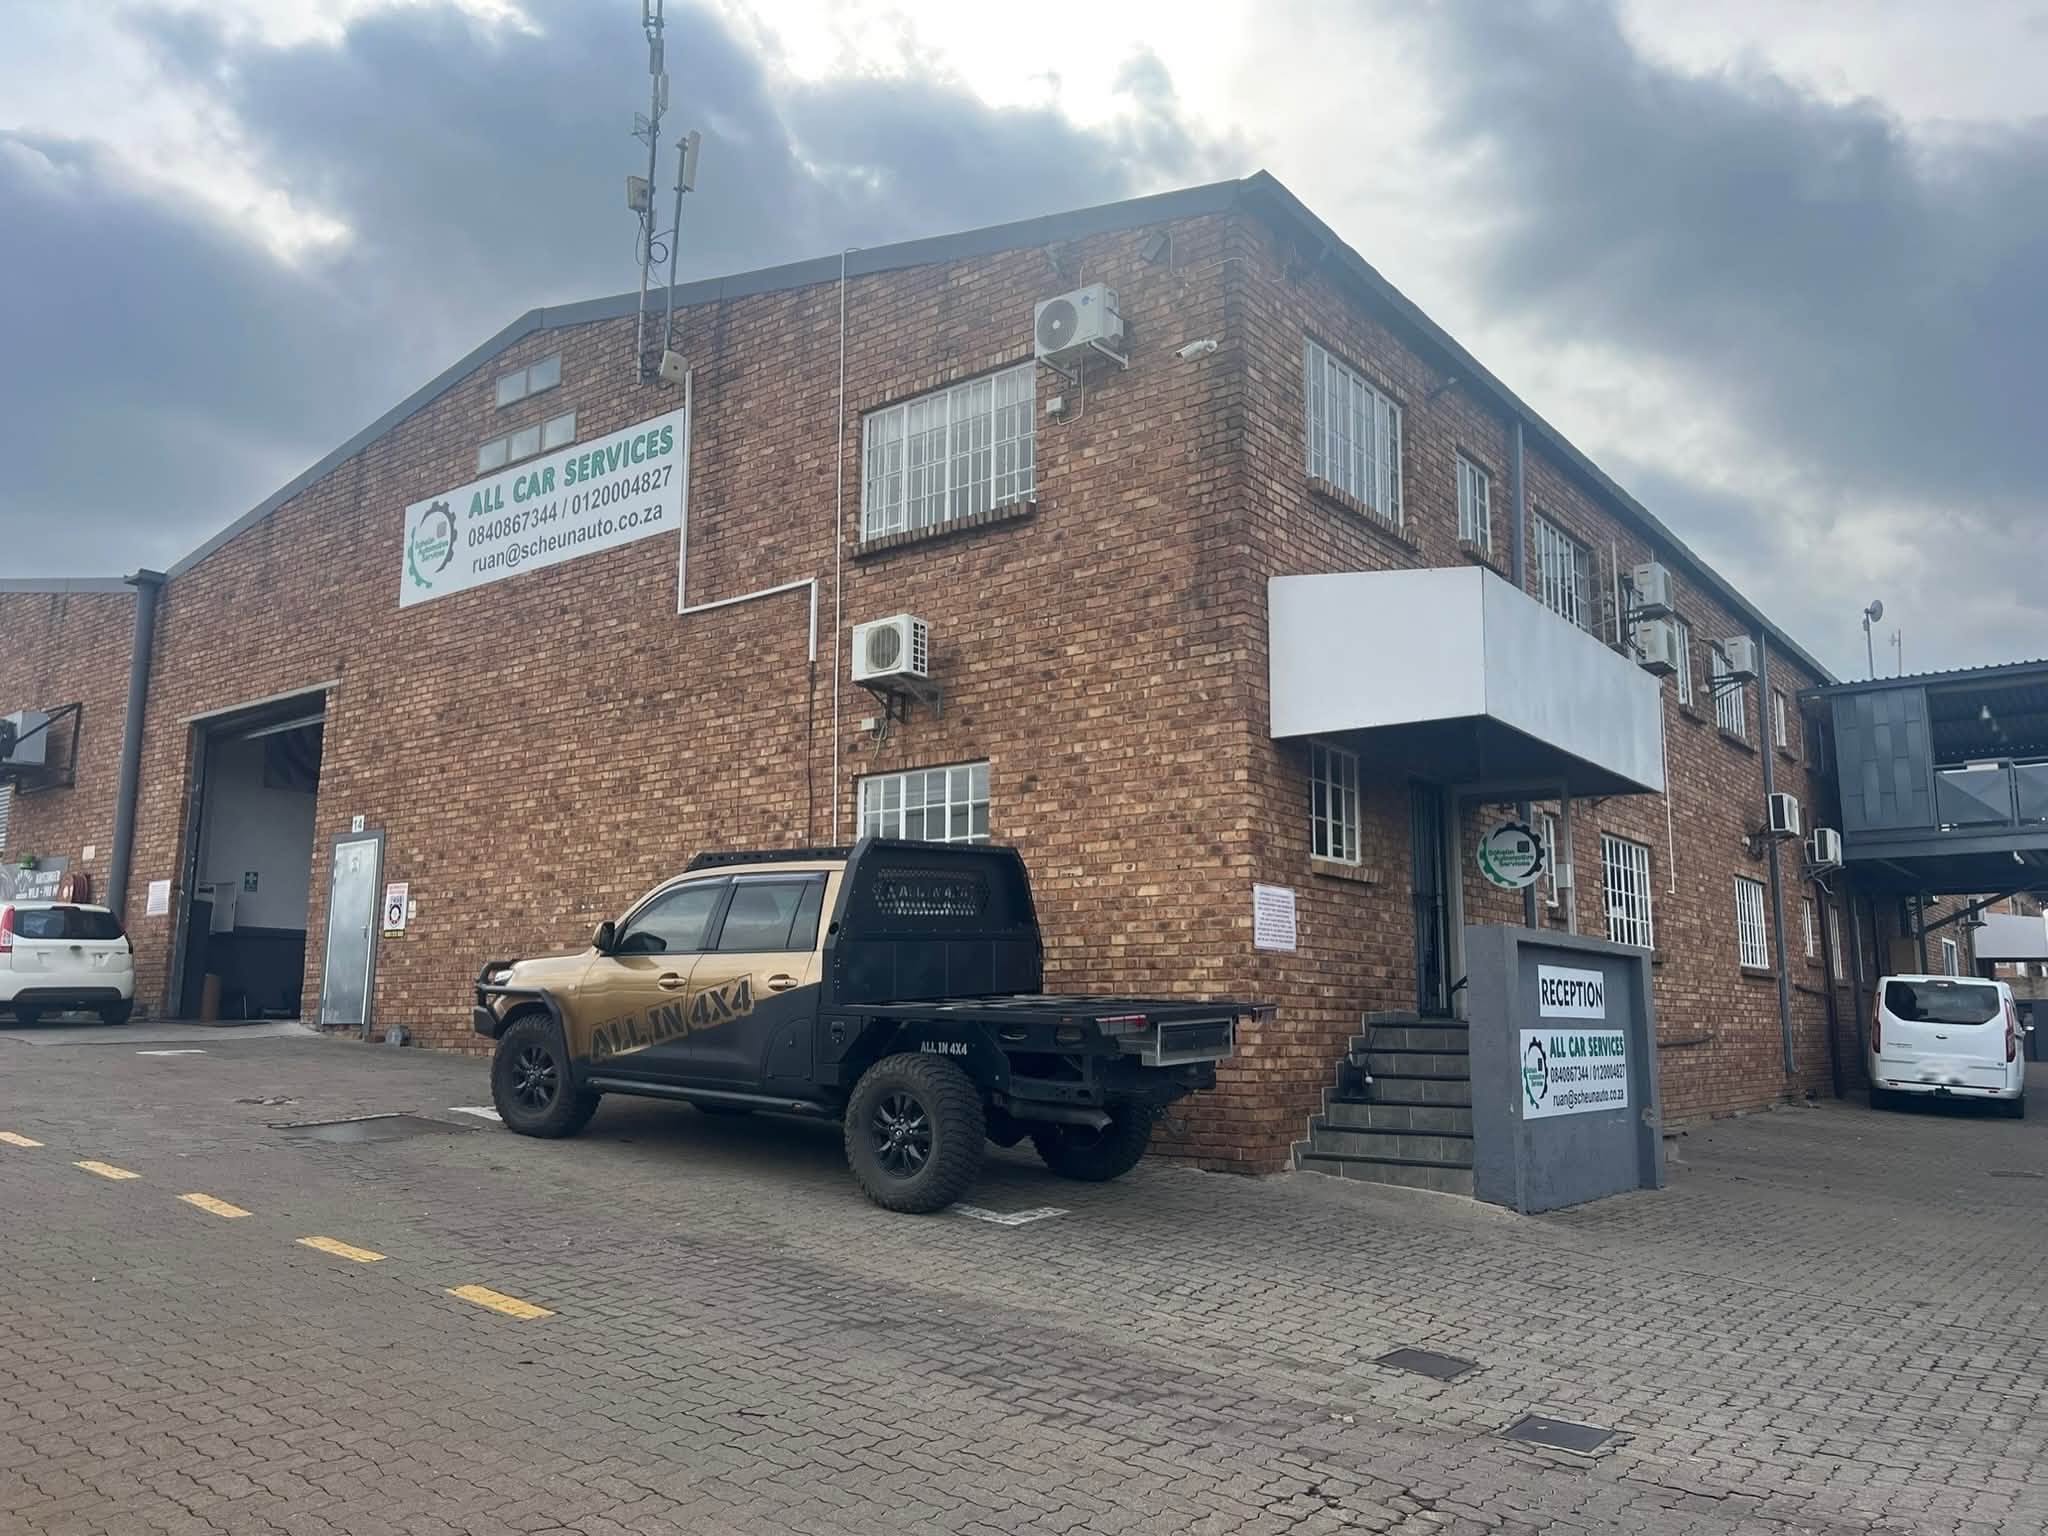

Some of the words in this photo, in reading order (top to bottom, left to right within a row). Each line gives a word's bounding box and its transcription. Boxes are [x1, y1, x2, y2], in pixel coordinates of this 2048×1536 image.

[468, 484, 505, 519] ALL
[513, 466, 555, 504] CAR
[564, 425, 674, 487] SERVICES
[468, 502, 557, 548] 0840867344
[571, 465, 673, 516] 0120004827
[472, 503, 663, 574] ruan@scheunauto.co.za
[590, 1019, 651, 1063] ALL
[648, 997, 688, 1039] IN
[687, 974, 755, 1031] 4X4
[1541, 978, 1603, 1008] RECEPTION
[920, 1041, 936, 1054] ALL
[938, 1042, 948, 1055] IN
[949, 1041, 968, 1056] 4X4
[1549, 1036, 1566, 1058] ALL
[1569, 1036, 1586, 1058] CAR
[1588, 1036, 1624, 1057] SERVICES
